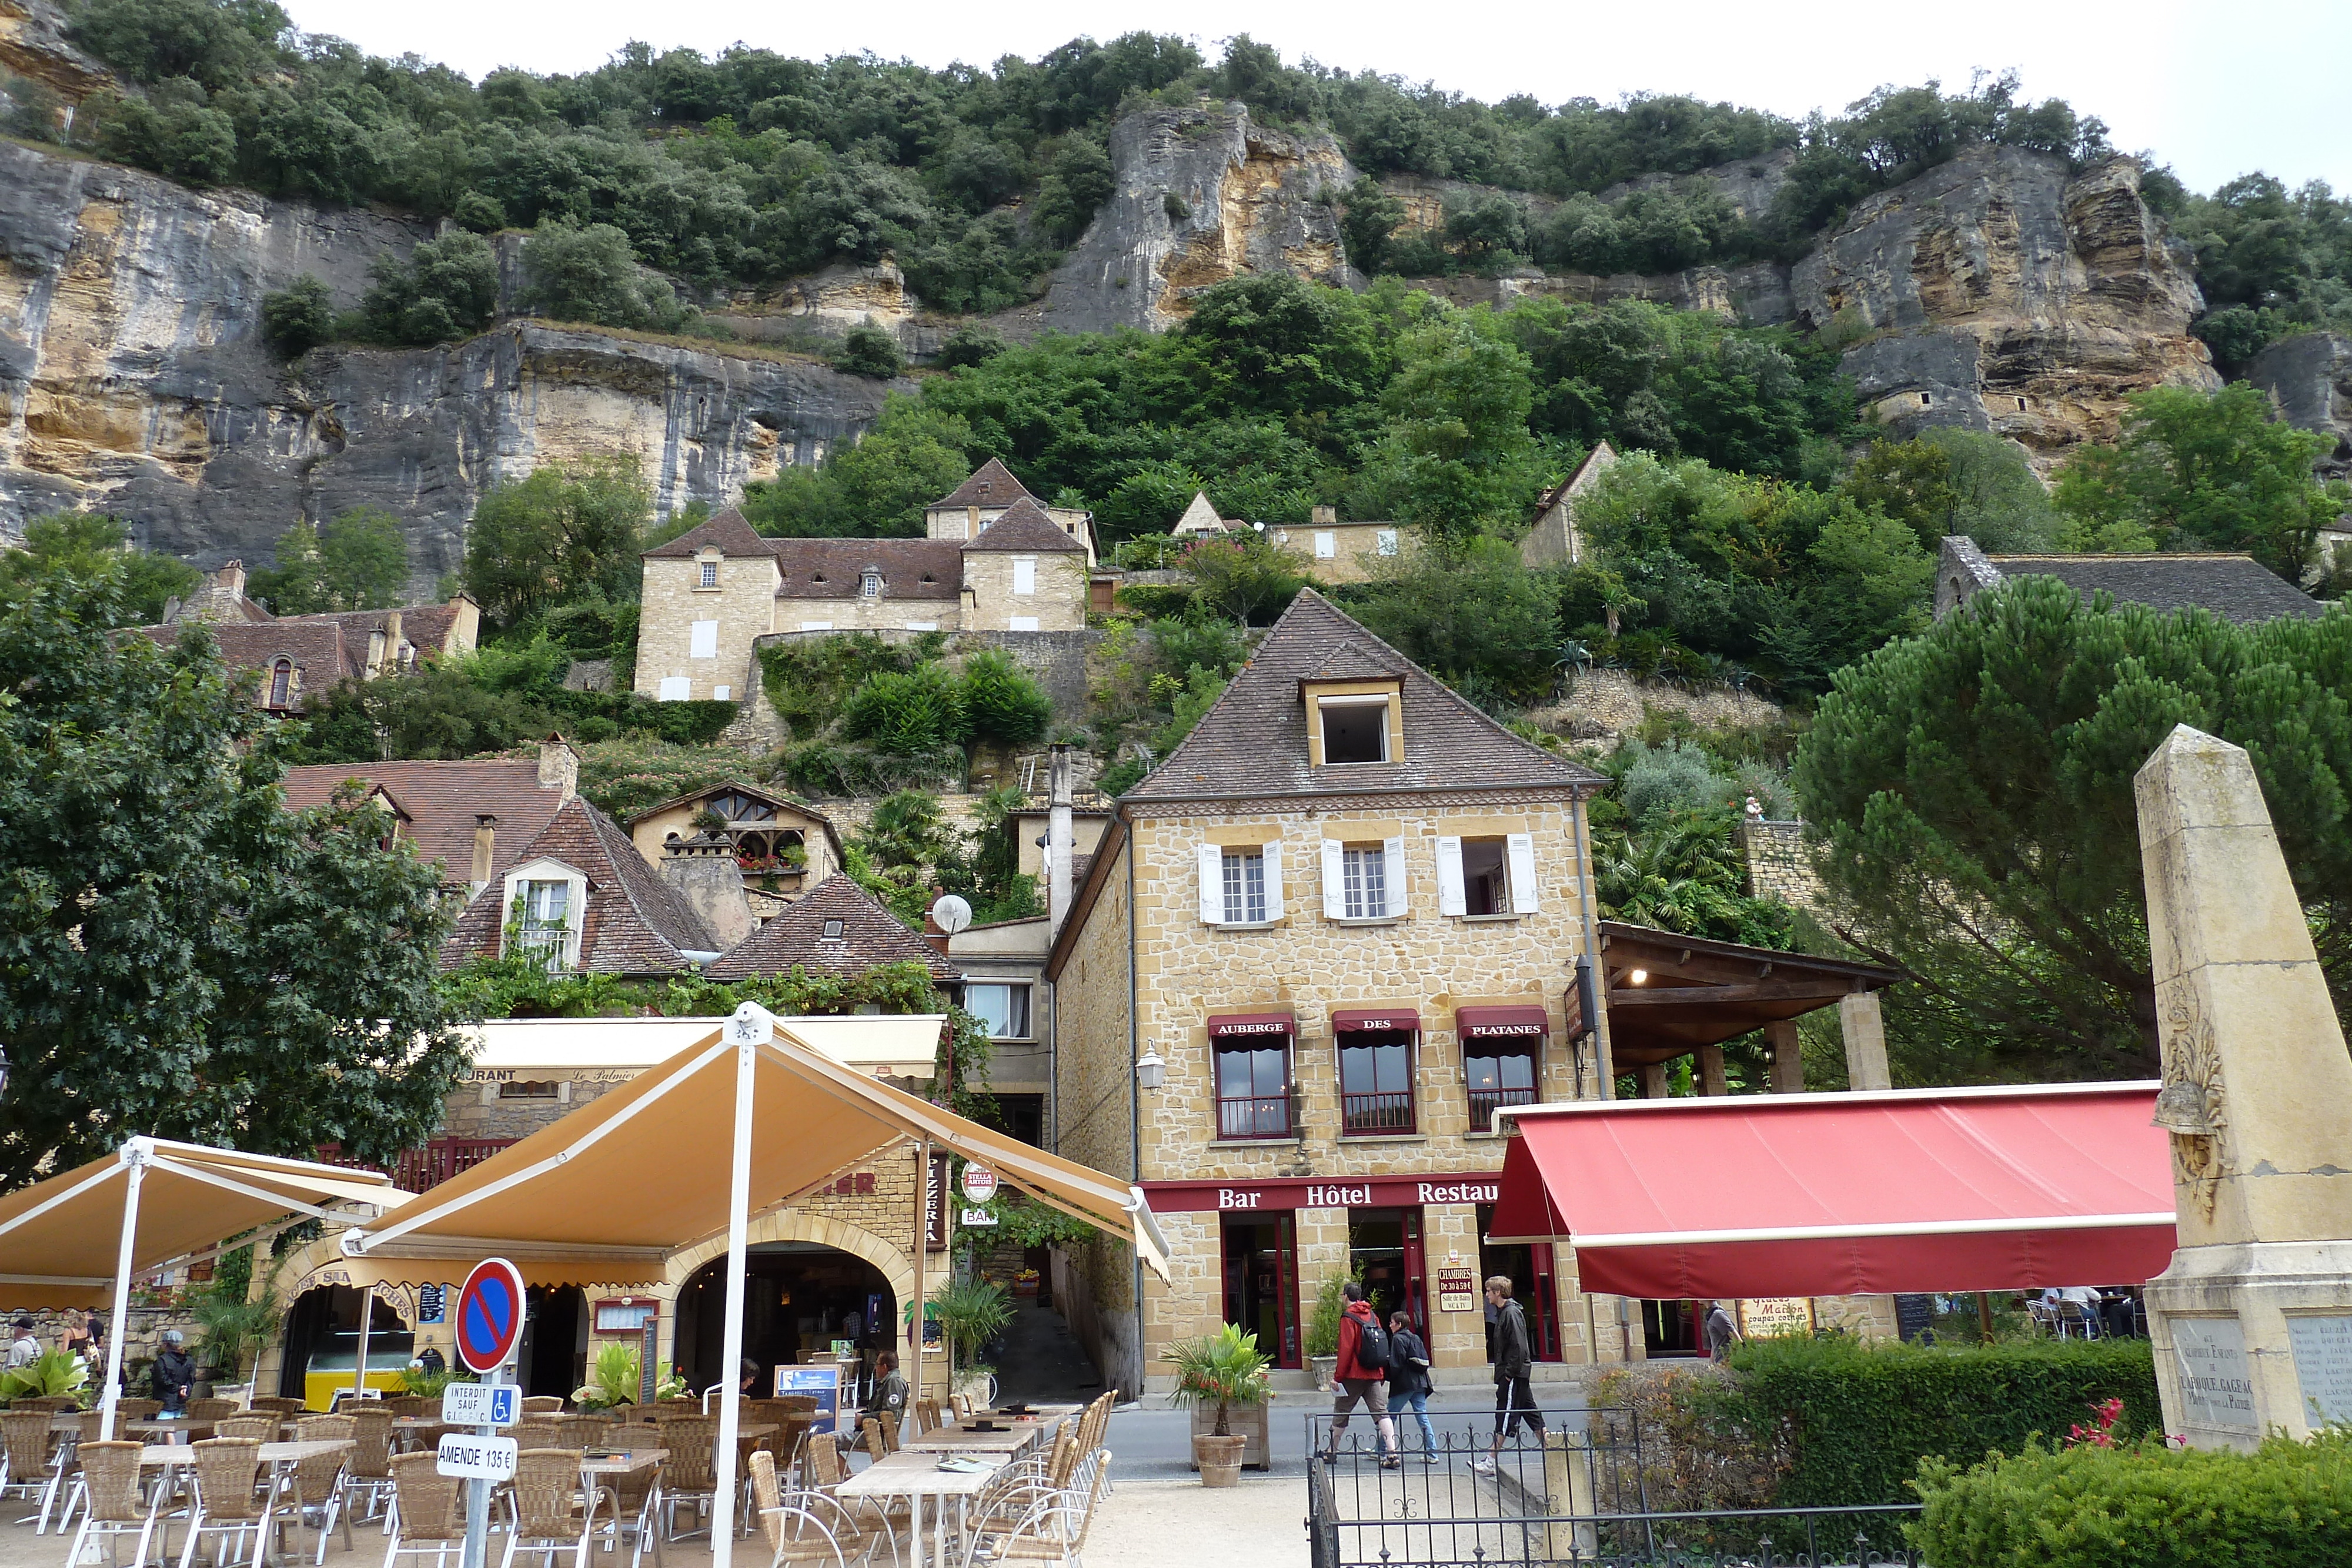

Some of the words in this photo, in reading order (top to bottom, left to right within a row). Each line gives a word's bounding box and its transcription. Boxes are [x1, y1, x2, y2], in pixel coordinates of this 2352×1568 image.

[1218, 1023, 1284, 1034] AUBERGE
[1363, 1019, 1391, 1029] DES
[1472, 1025, 1541, 1035] PLATANES
[572, 1069, 586, 1080] Le
[593, 1069, 634, 1080] Palmier
[1218, 1188, 1261, 1208] Bar
[1307, 1183, 1372, 1205] Hôtel
[926, 1159, 938, 1241] PIZZERIA
[967, 1211, 993, 1222] BAR
[1439, 1269, 1471, 1279] CHAMBRES
[1455, 1281, 1459, 1290] à
[1749, 1315, 1775, 1324] coupes
[451, 1388, 486, 1398] INTERDIT
[457, 1400, 478, 1410] SAUF
[438, 1445, 481, 1466] AMENDE
[486, 1449, 502, 1468] 135
[505, 1451, 511, 1469] €
